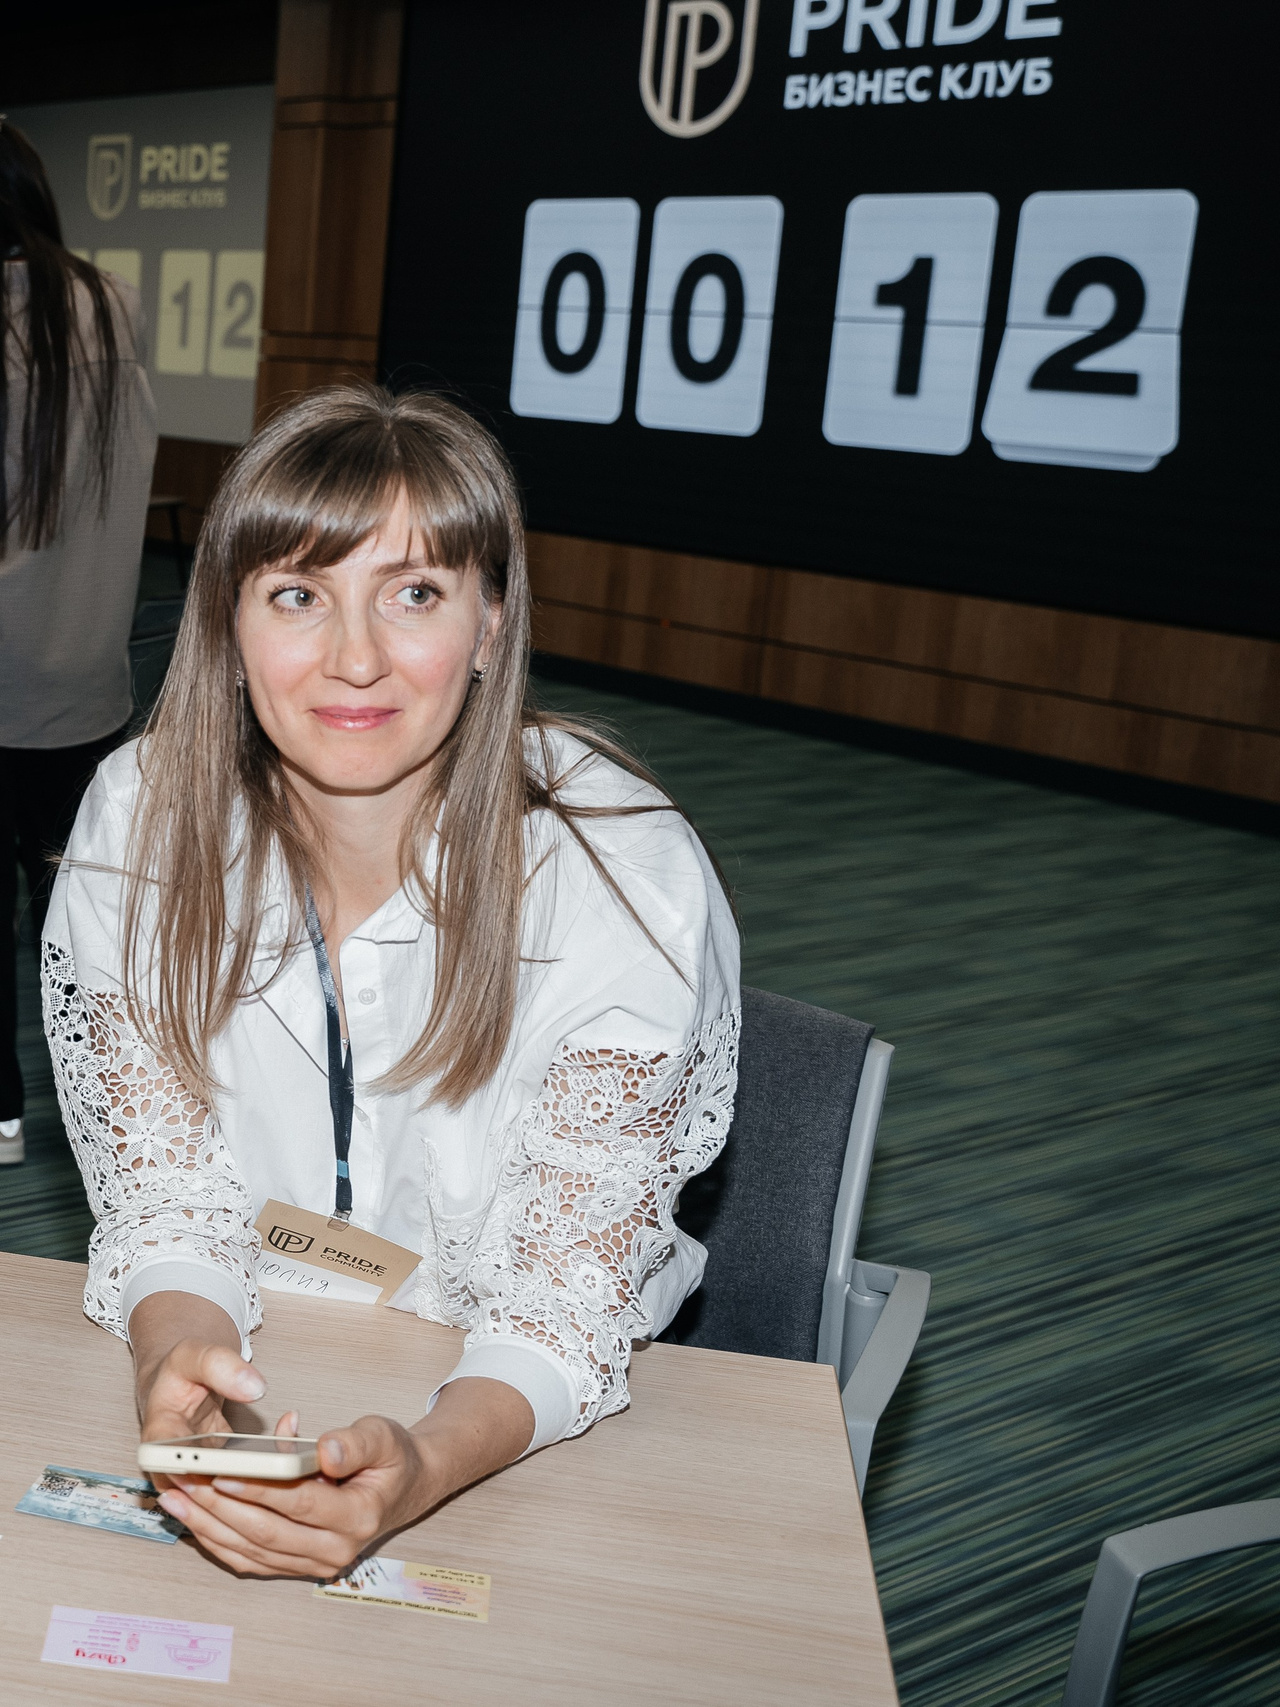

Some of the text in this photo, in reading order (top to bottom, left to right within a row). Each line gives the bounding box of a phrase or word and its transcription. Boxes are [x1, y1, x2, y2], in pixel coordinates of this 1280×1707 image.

[789, 0, 1063, 57] PRIDE
[783, 57, 1053, 109] БИЗНЕС КЛУБ
[140, 141, 230, 184] PRIDE
[258, 1260, 329, 1294] ЮЛИЯ
[320, 1254, 383, 1277] COMMUNITY
[323, 1247, 387, 1274] PRIDE
